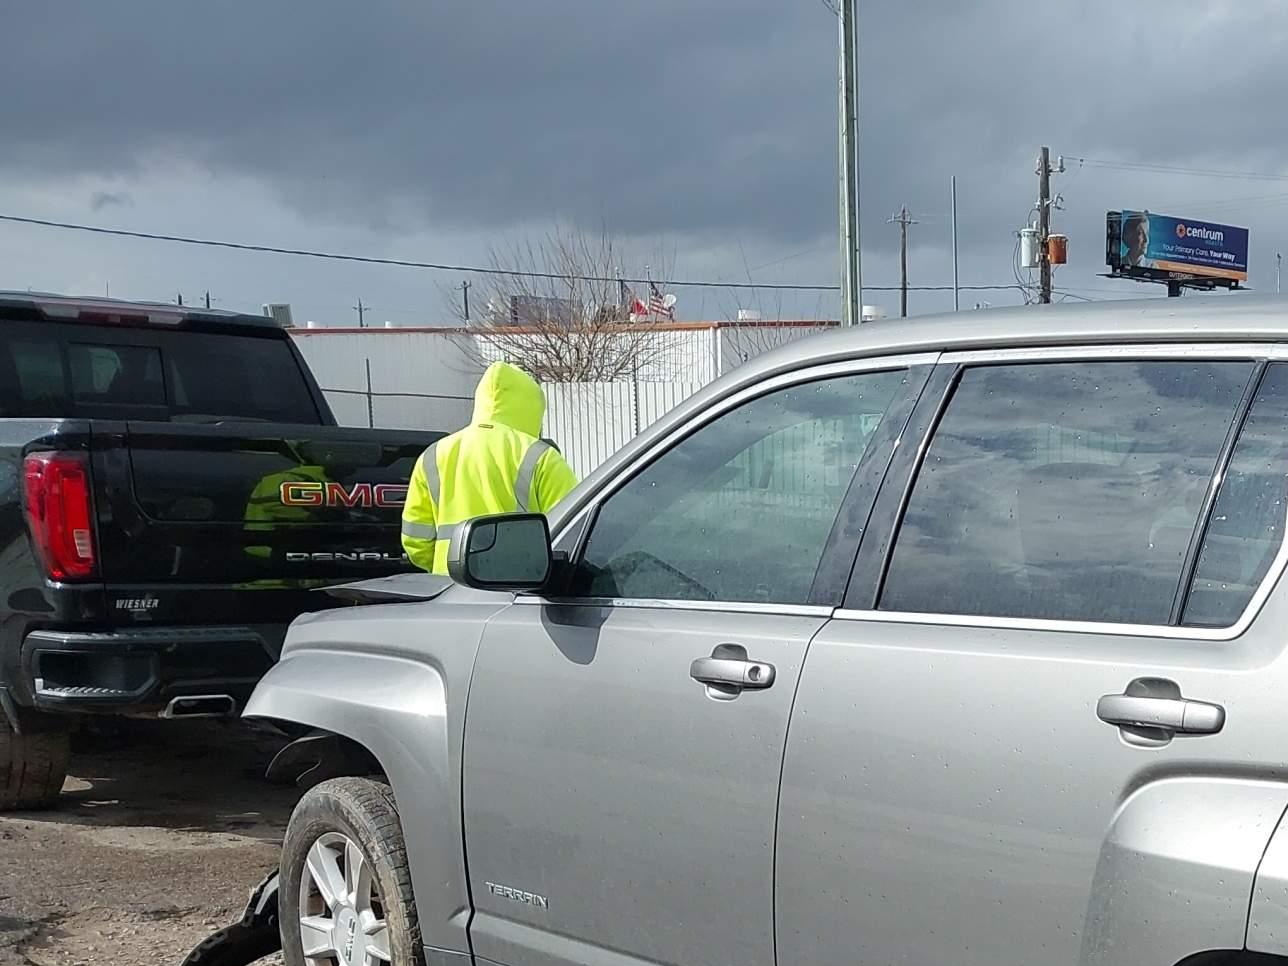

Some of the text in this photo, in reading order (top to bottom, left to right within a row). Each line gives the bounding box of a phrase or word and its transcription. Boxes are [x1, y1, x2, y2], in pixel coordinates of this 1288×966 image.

[1186, 225, 1224, 242] centrum
[1210, 250, 1222, 259] Your
[1222, 251, 1236, 262] Way
[280, 482, 409, 507] GMC
[116, 599, 159, 609] WIESNER
[485, 881, 550, 912] TERRAIN
